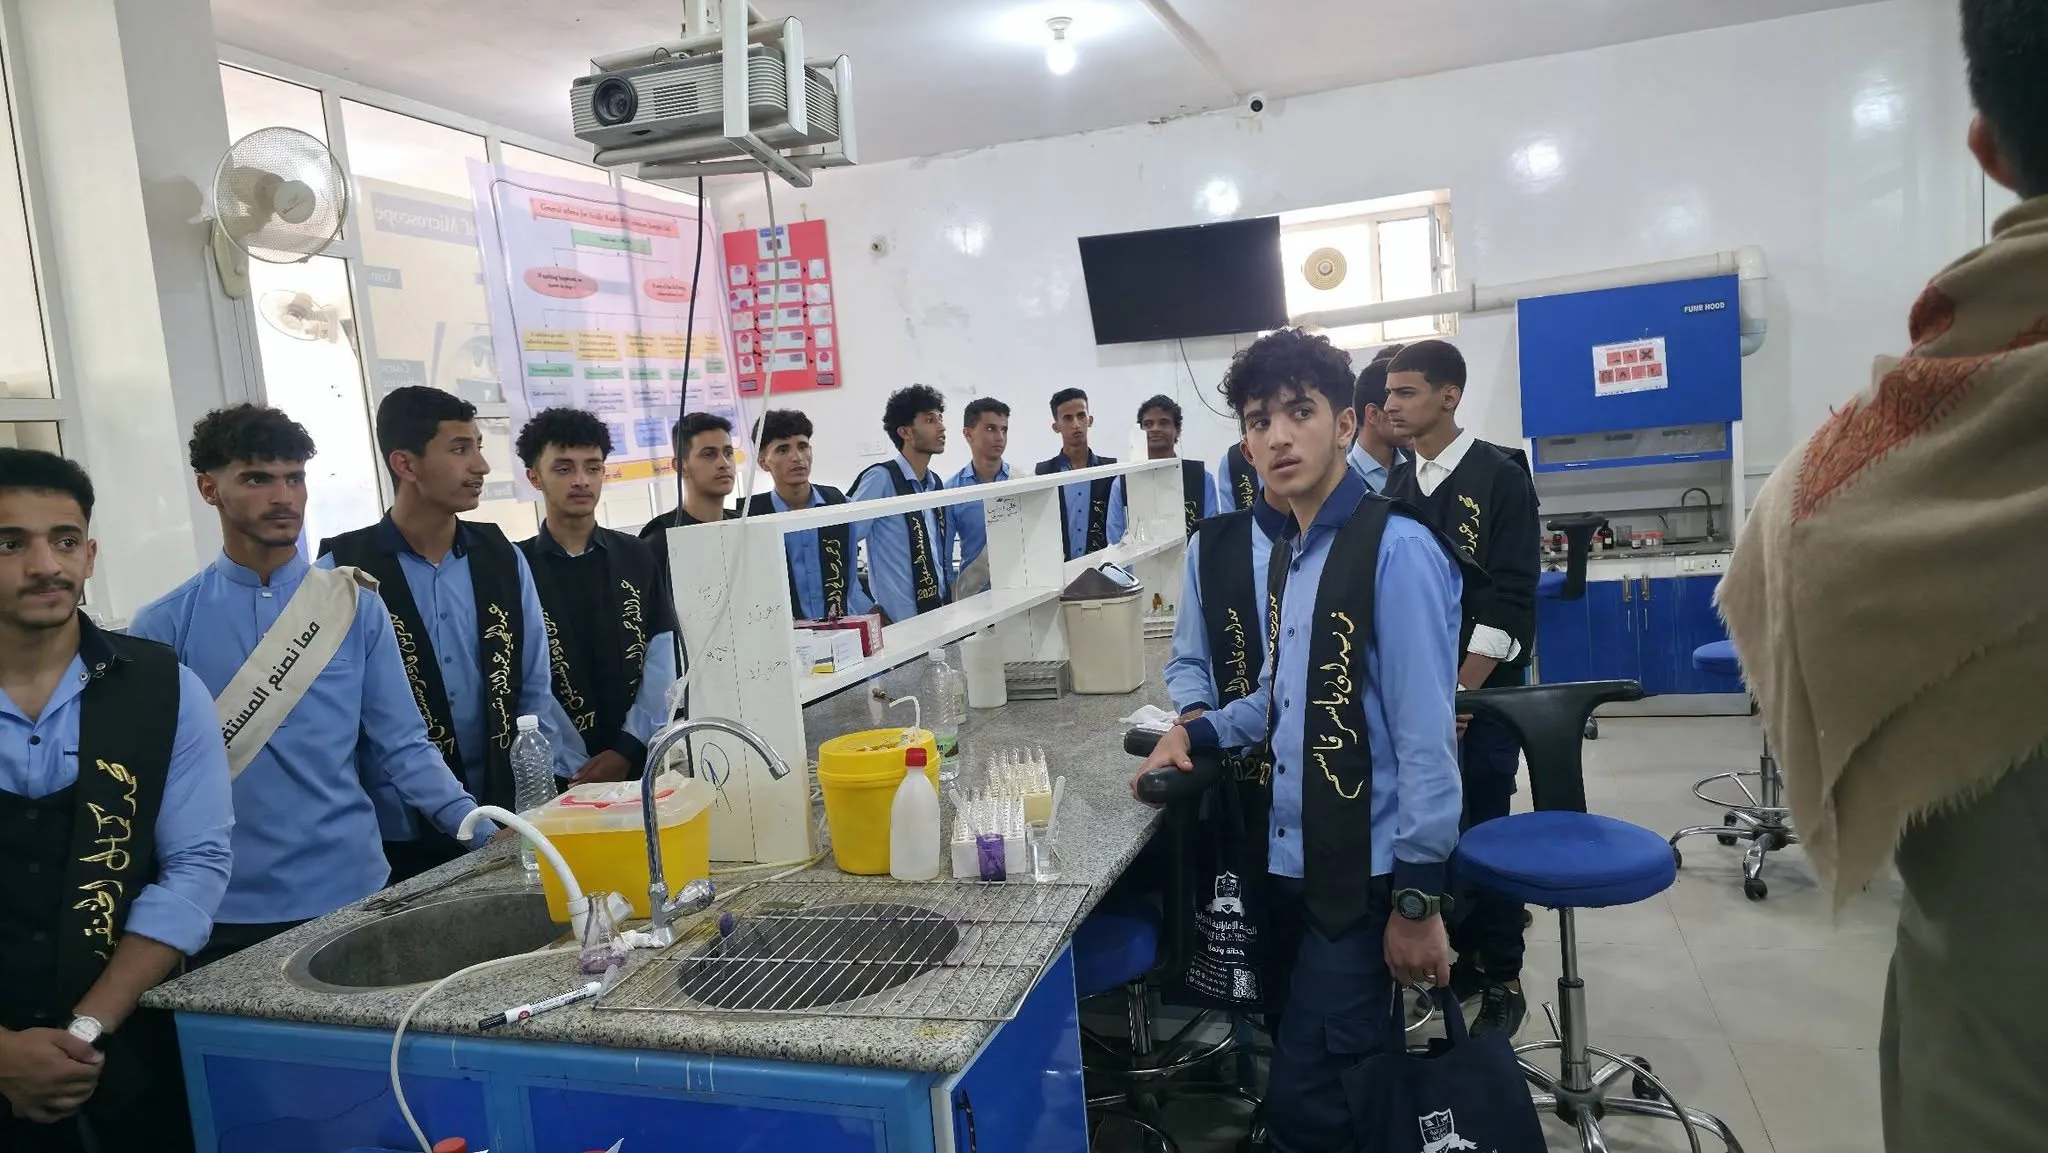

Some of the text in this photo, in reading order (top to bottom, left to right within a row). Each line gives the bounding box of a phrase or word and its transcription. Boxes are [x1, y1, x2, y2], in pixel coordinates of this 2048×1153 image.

[1684, 301, 1725, 313] FUME HOOD
[1457, 494, 1481, 528] محمد
[917, 585, 937, 601] 2027
[293, 621, 320, 649] معا
[268, 647, 301, 692] نصنع
[1311, 610, 1365, 799] زيدان ياسر قاسم
[95, 759, 137, 816] محمد
[79, 800, 133, 871] كمال
